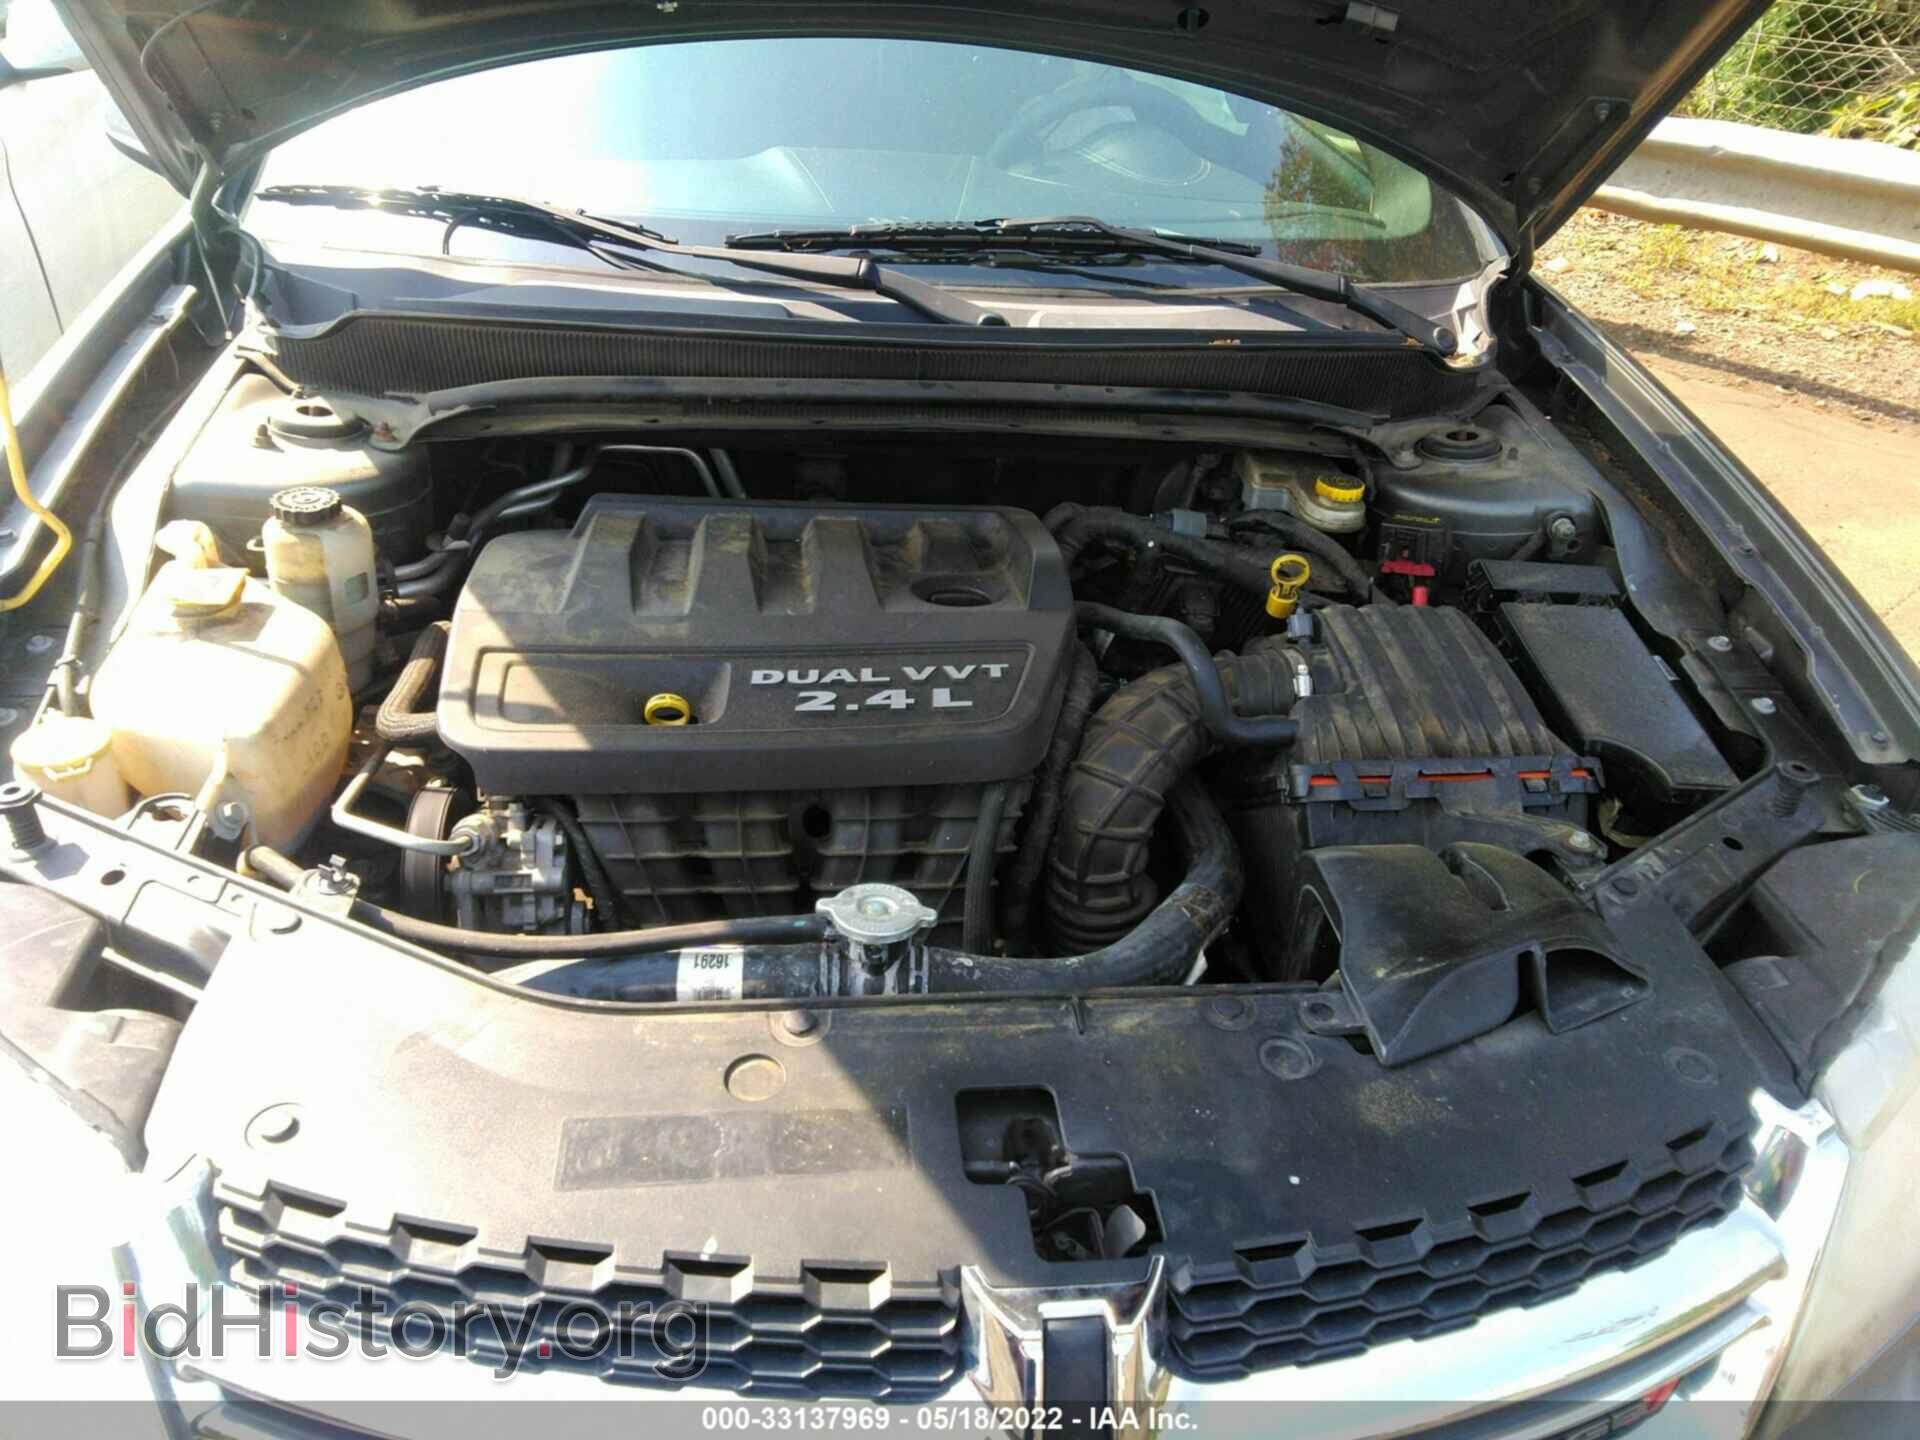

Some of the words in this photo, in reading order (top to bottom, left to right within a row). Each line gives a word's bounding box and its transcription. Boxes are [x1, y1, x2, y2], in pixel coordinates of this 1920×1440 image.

[751, 667, 891, 685] DUAL
[901, 663, 1010, 682] VVT
[794, 688, 916, 712] 2.4
[931, 687, 974, 708] L
[693, 952, 730, 969] 16291
